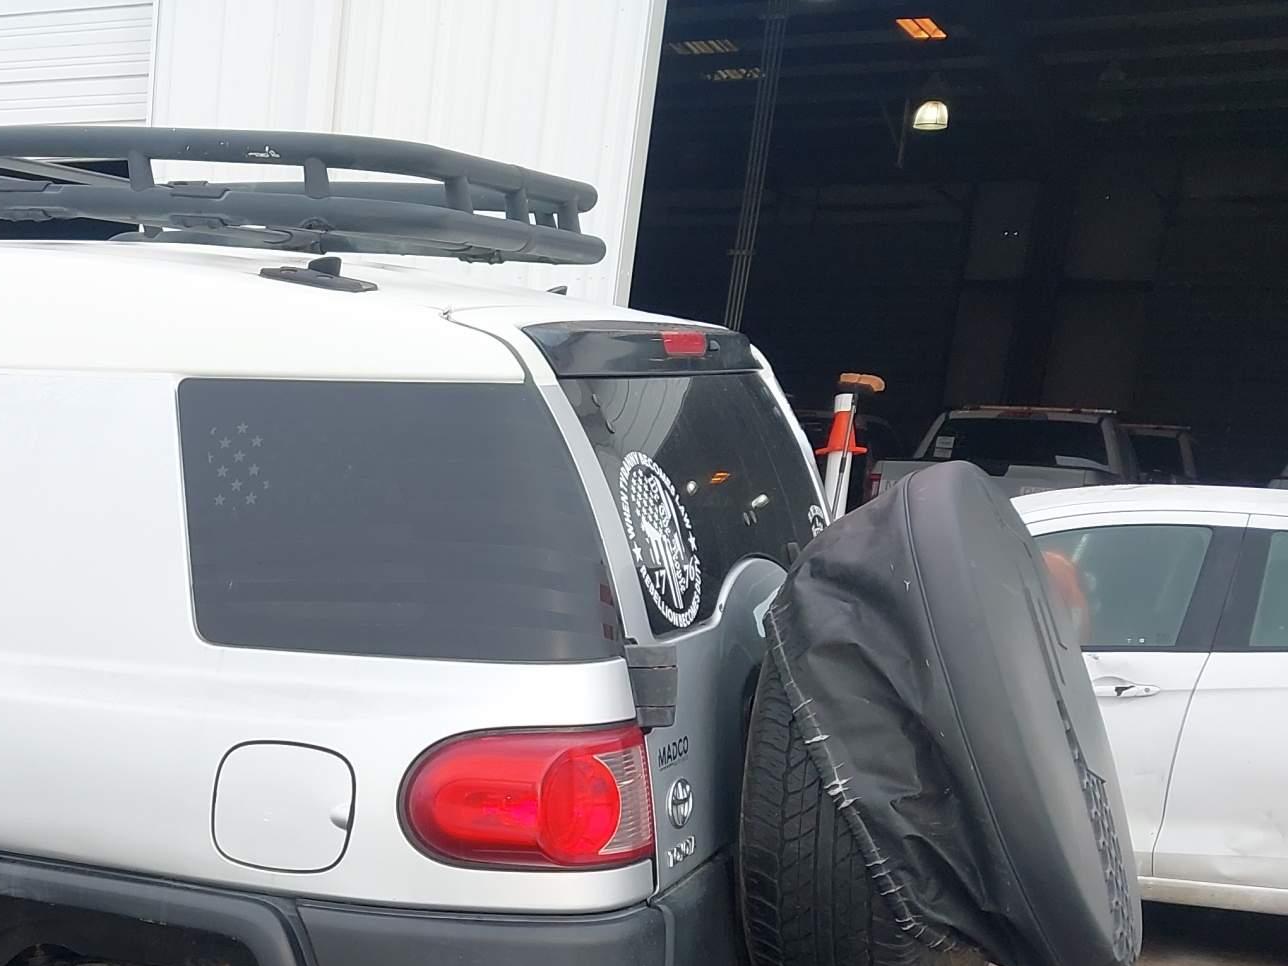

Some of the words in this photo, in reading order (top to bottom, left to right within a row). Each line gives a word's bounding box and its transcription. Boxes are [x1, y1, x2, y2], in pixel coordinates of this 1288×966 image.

[619, 451, 642, 492] TYRANNY
[638, 451, 676, 496] BECOMES
[620, 490, 636, 540] WHEN
[675, 494, 692, 530] LAW
[640, 564, 679, 627] REBELLION
[678, 591, 701, 628] BECOMES
[693, 554, 702, 595] DUTY
[655, 569, 666, 595] 17
[683, 556, 695, 589] 76
[658, 735, 689, 768] MADCO
